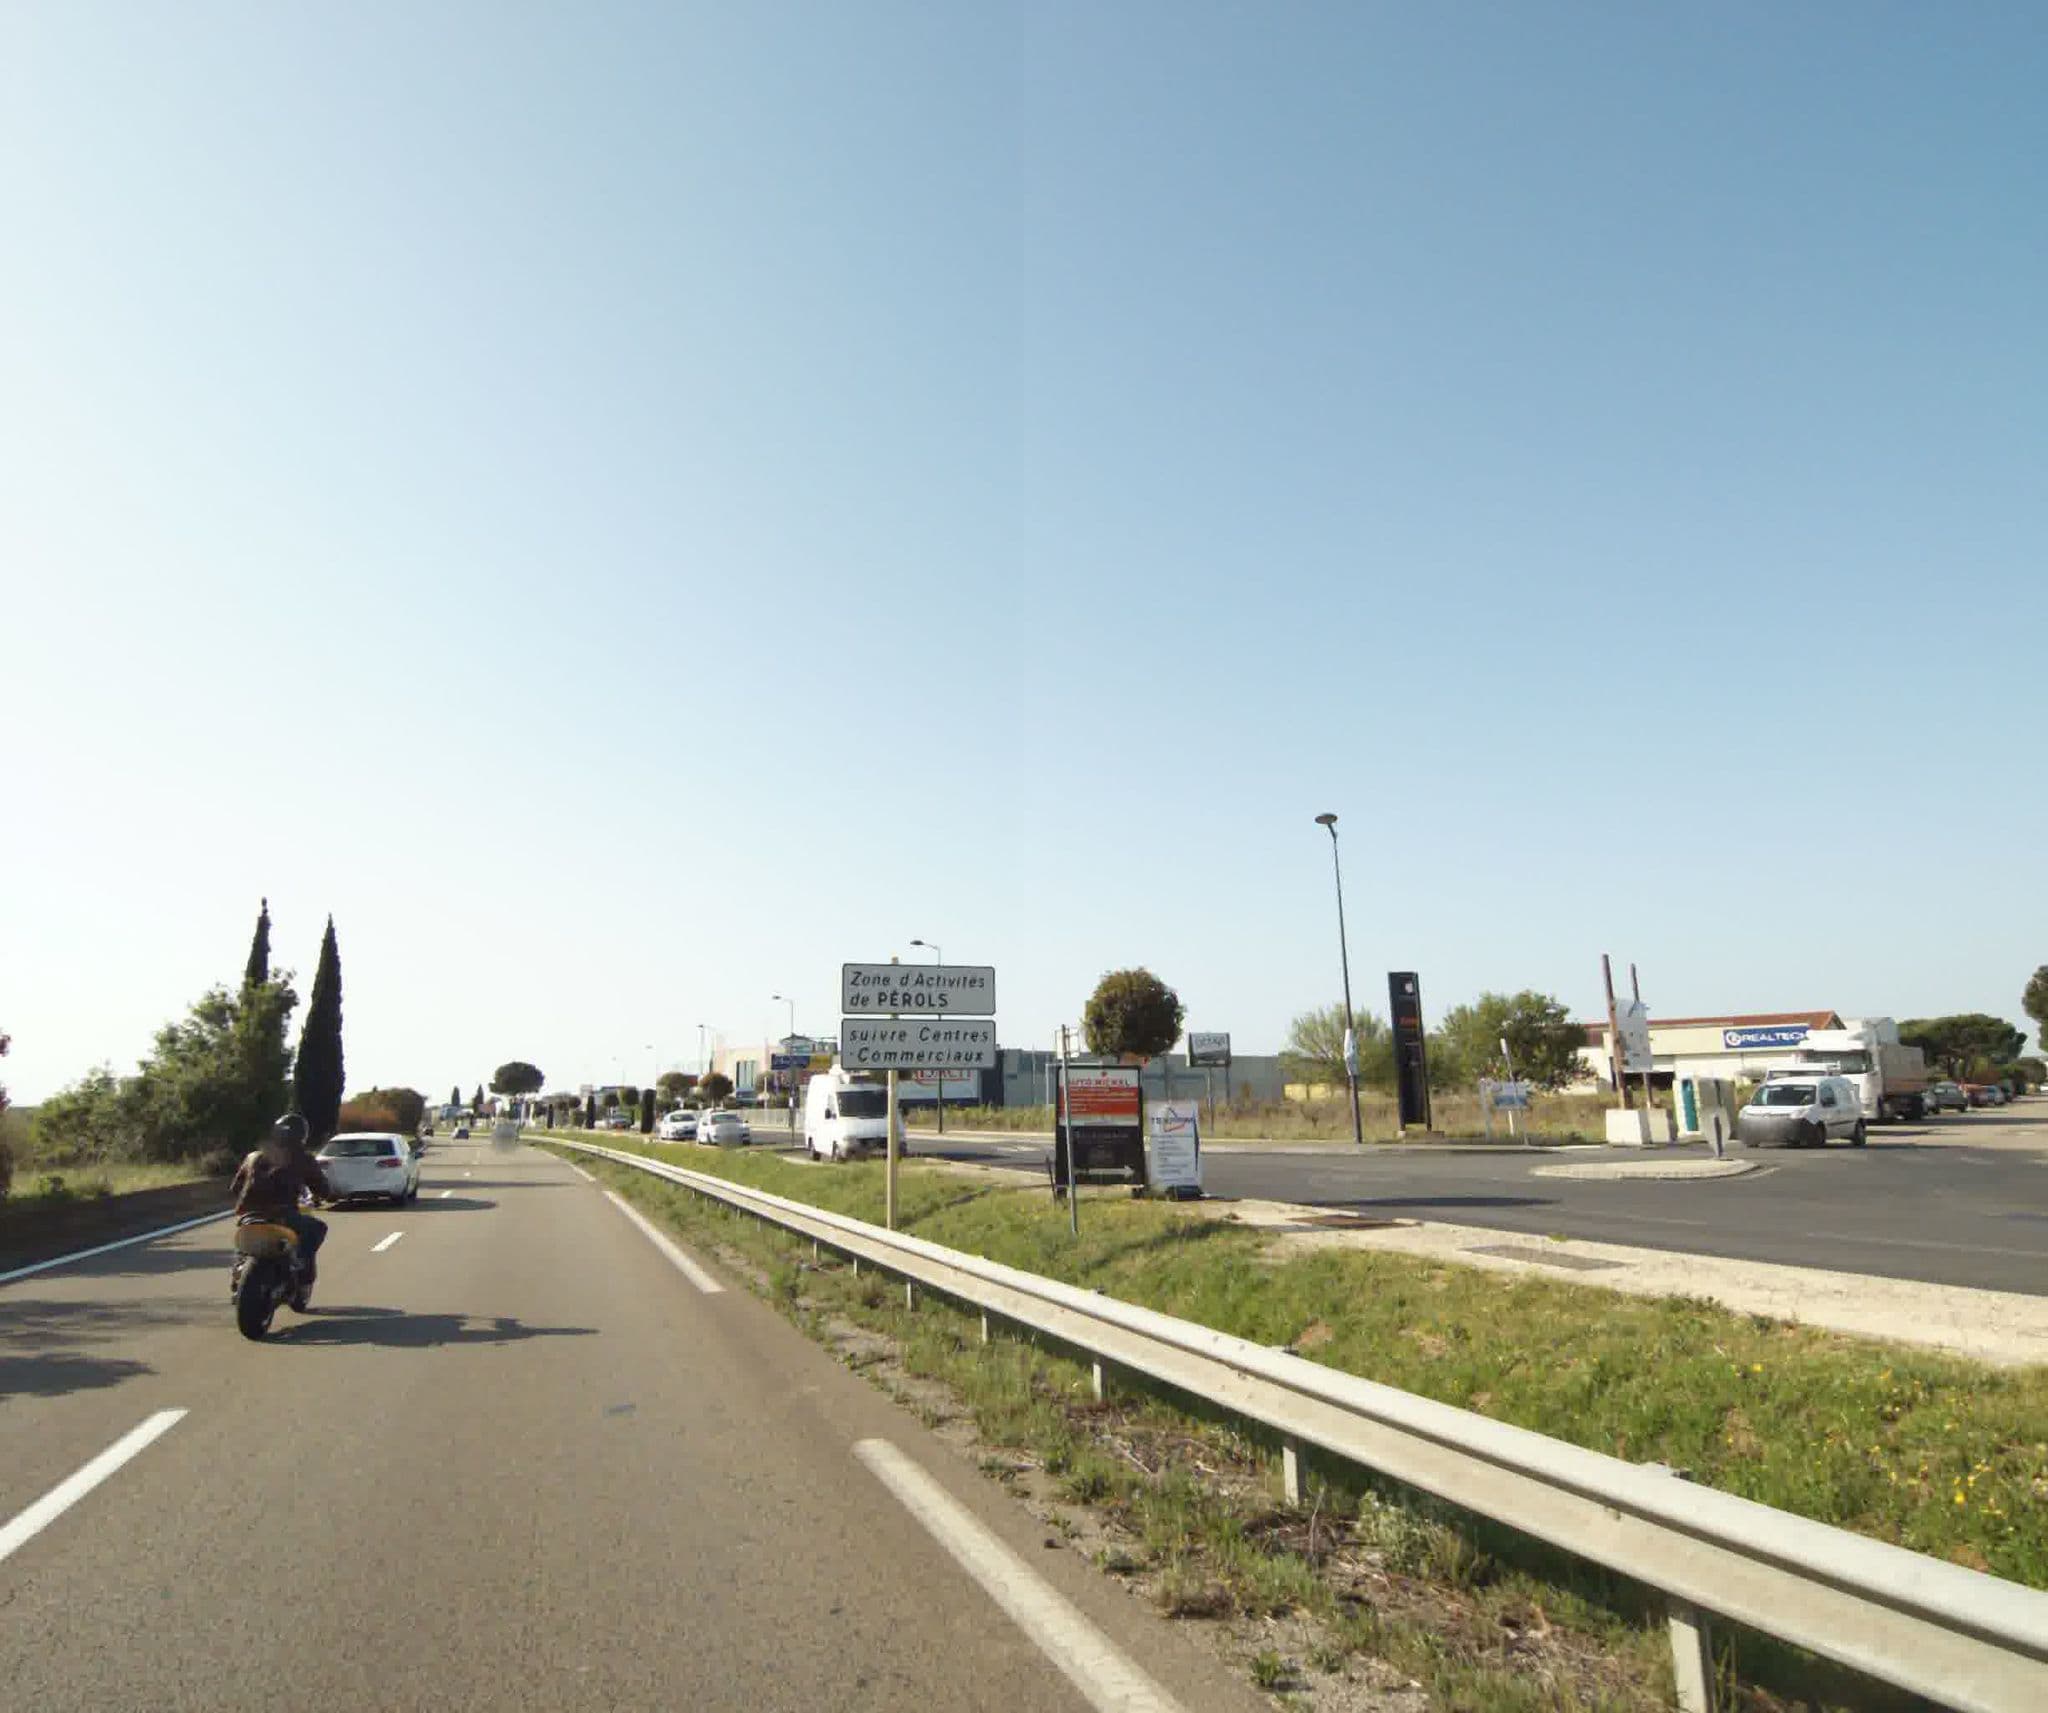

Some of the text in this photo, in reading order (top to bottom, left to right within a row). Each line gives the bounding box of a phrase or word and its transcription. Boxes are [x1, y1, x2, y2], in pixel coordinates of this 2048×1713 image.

[850, 971, 891, 986] Zone
[849, 990, 949, 1008] de PÉROLS
[849, 1026, 989, 1044] suivre Centres
[857, 1046, 985, 1064] Commerciaux
